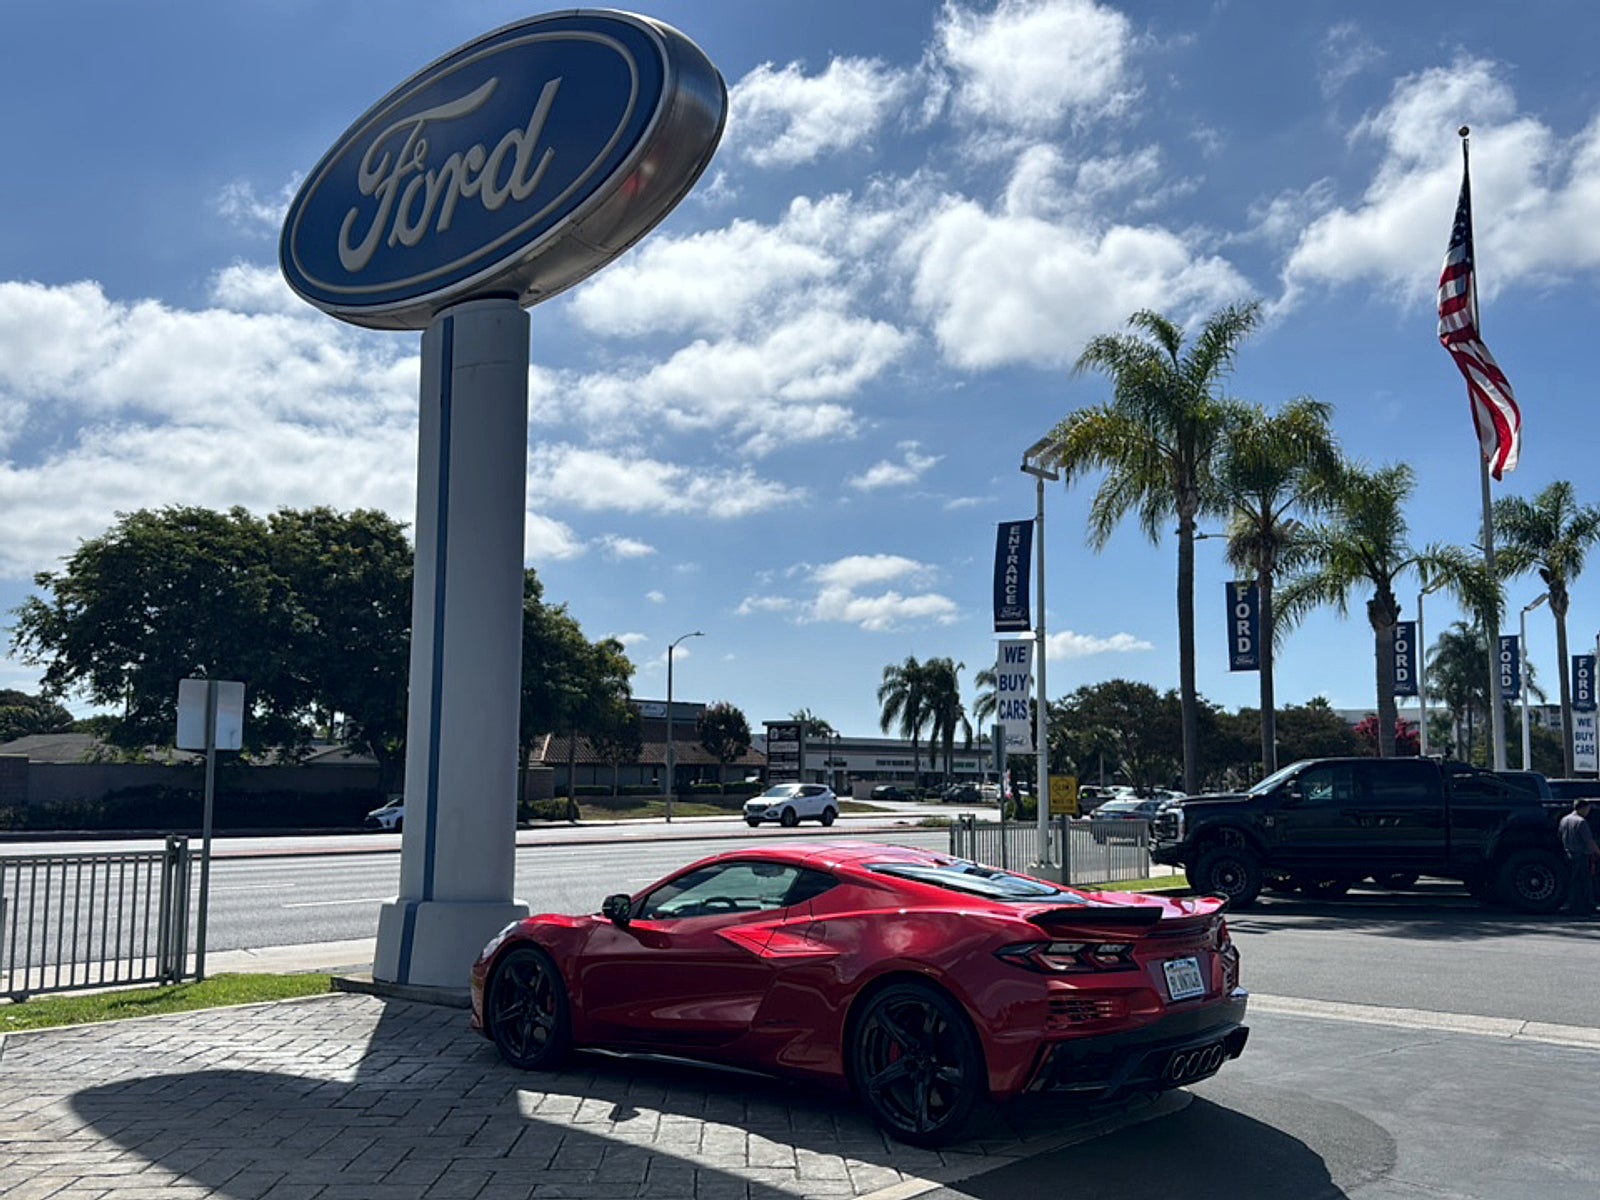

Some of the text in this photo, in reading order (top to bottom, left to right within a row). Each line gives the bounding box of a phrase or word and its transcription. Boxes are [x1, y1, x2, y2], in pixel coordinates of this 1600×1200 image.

[339, 77, 563, 272] Ford
[1005, 525, 1020, 605] ENTRANCE
[1235, 586, 1251, 653] FORD
[1005, 646, 1026, 663] WE
[1395, 626, 1408, 681] FORD
[1501, 639, 1512, 686] FORD
[1000, 675, 1027, 691] BUY
[1578, 658, 1588, 700] FORD
[1000, 699, 1027, 720] CARS
[1577, 718, 1592, 728] WE
[1575, 732, 1594, 741] BUY
[1576, 744, 1594, 755] CARS
